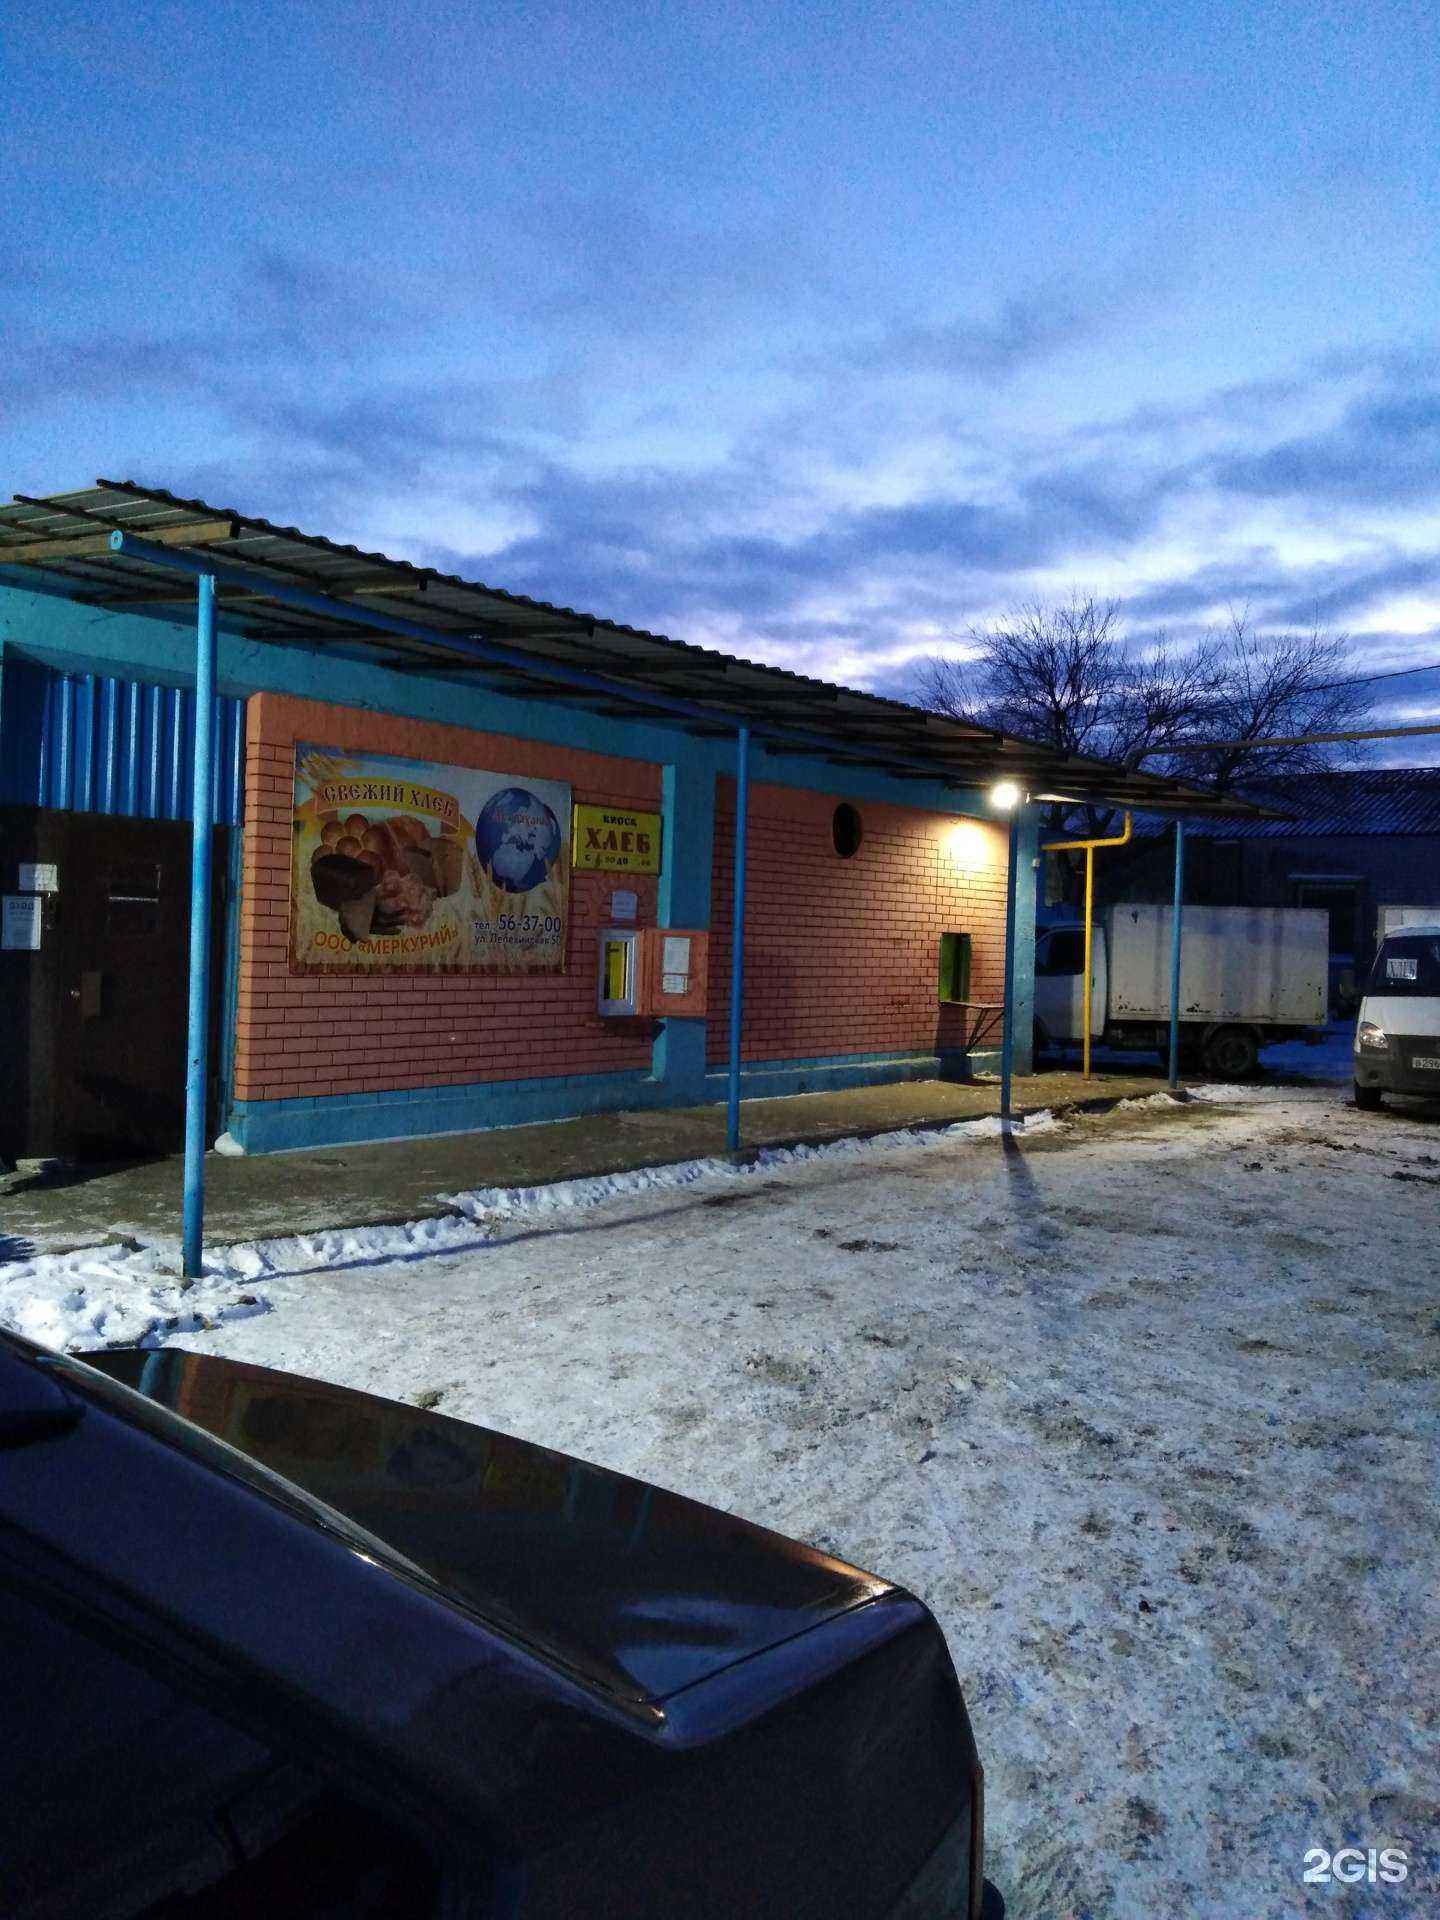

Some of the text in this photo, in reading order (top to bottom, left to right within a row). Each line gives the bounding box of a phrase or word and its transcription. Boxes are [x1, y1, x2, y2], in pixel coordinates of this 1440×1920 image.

[323, 783, 453, 817] СВЕЖИЙ ХЛЕБ
[585, 827, 651, 855] ХЛЕБ
[499, 914, 561, 932] 56-37-00
[314, 930, 352, 952] ООО
